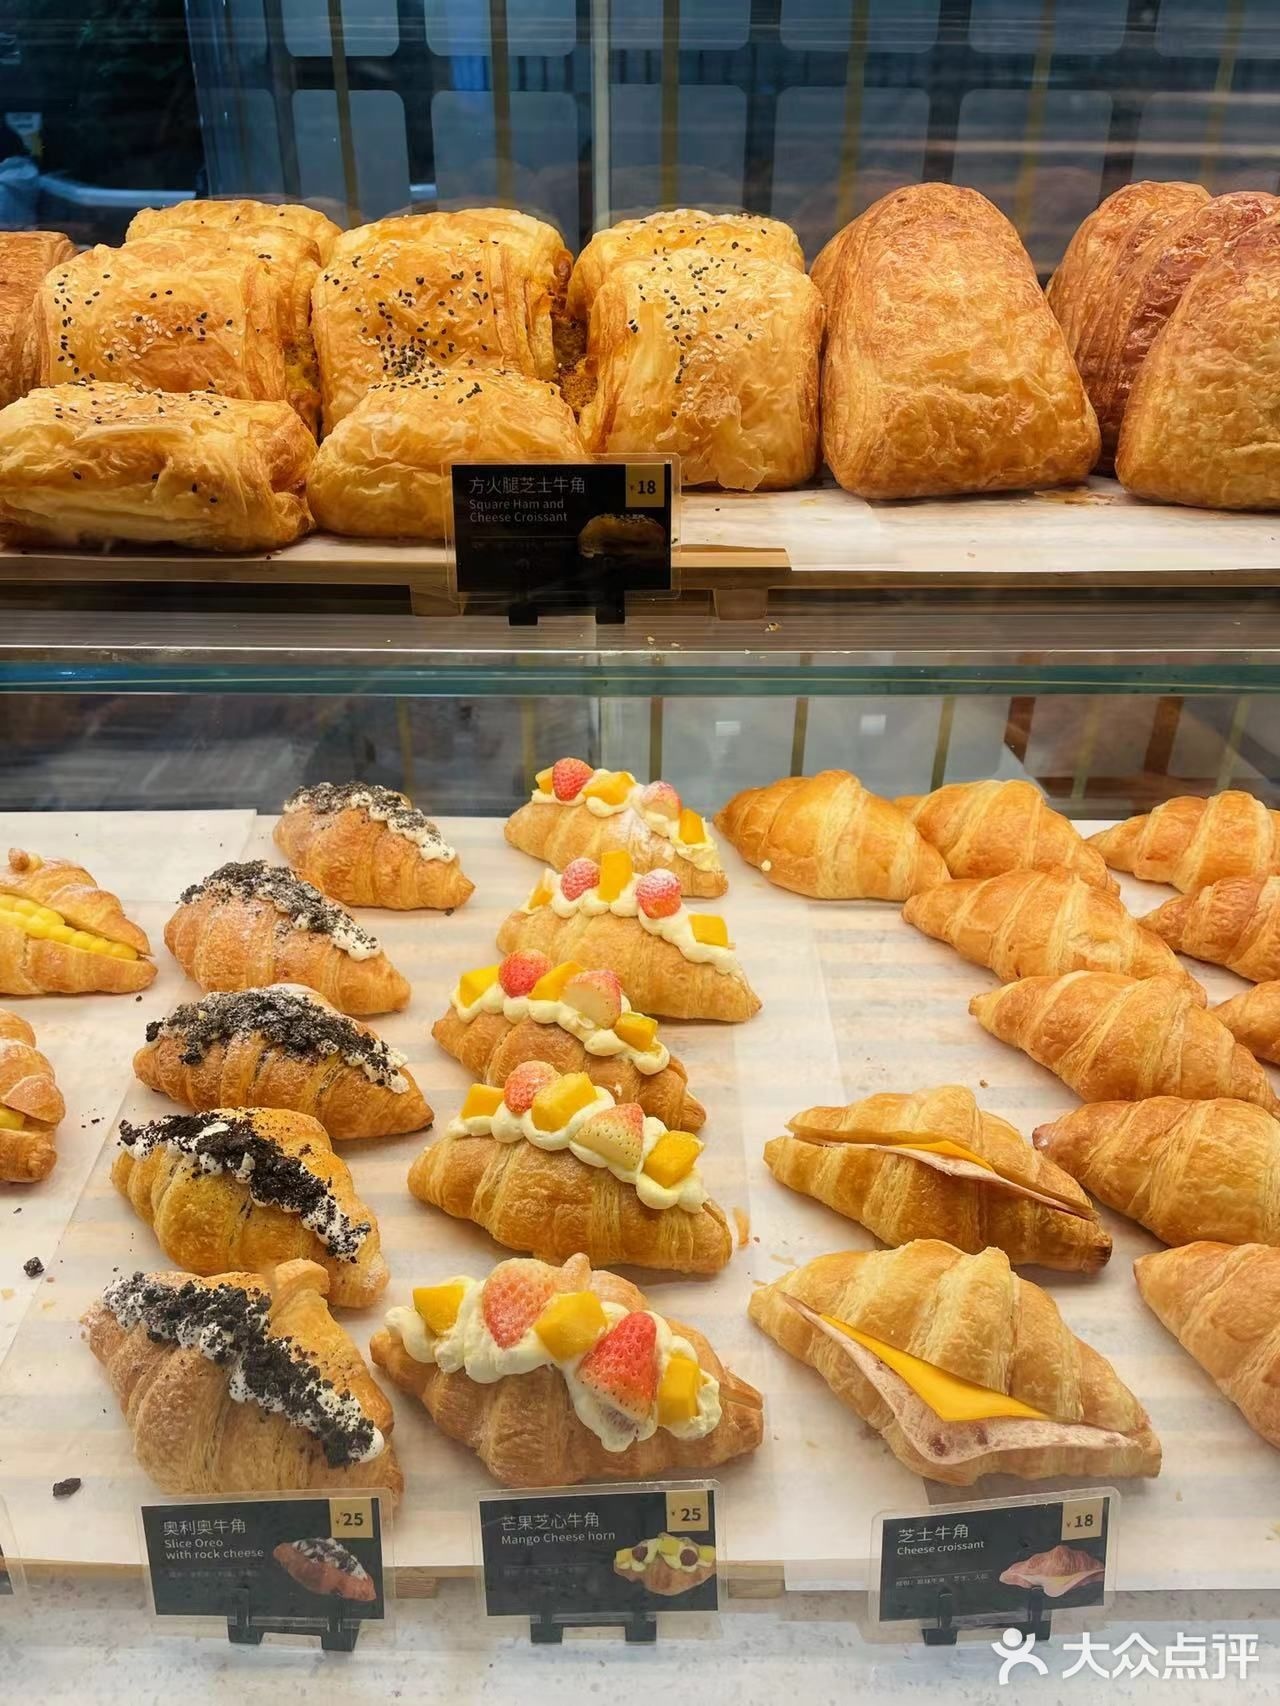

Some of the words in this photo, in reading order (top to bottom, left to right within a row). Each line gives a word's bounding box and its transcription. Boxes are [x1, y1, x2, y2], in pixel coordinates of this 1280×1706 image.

[468, 476, 586, 495] 方火腿芝士牛角
[469, 498, 510, 511] Square
[513, 498, 540, 509] Ham
[543, 498, 564, 509] and
[469, 511, 511, 523] Cheese
[514, 511, 568, 523] Croissant
[163, 1518, 246, 1537] 奥利奥牛角
[501, 1512, 600, 1531] 芒果芝心牛角
[501, 1533, 540, 1546] Mango
[543, 1532, 585, 1544] Cheese
[588, 1530, 616, 1542] horn
[897, 1523, 969, 1544] 芝士牛角
[164, 1538, 193, 1549] Slice
[194, 1537, 224, 1548] Oreo
[896, 1544, 935, 1557] Cheese
[937, 1540, 985, 1553] croissant
[165, 1549, 192, 1561] with
[194, 1548, 221, 1560] rock
[223, 1547, 265, 1559] cheese
